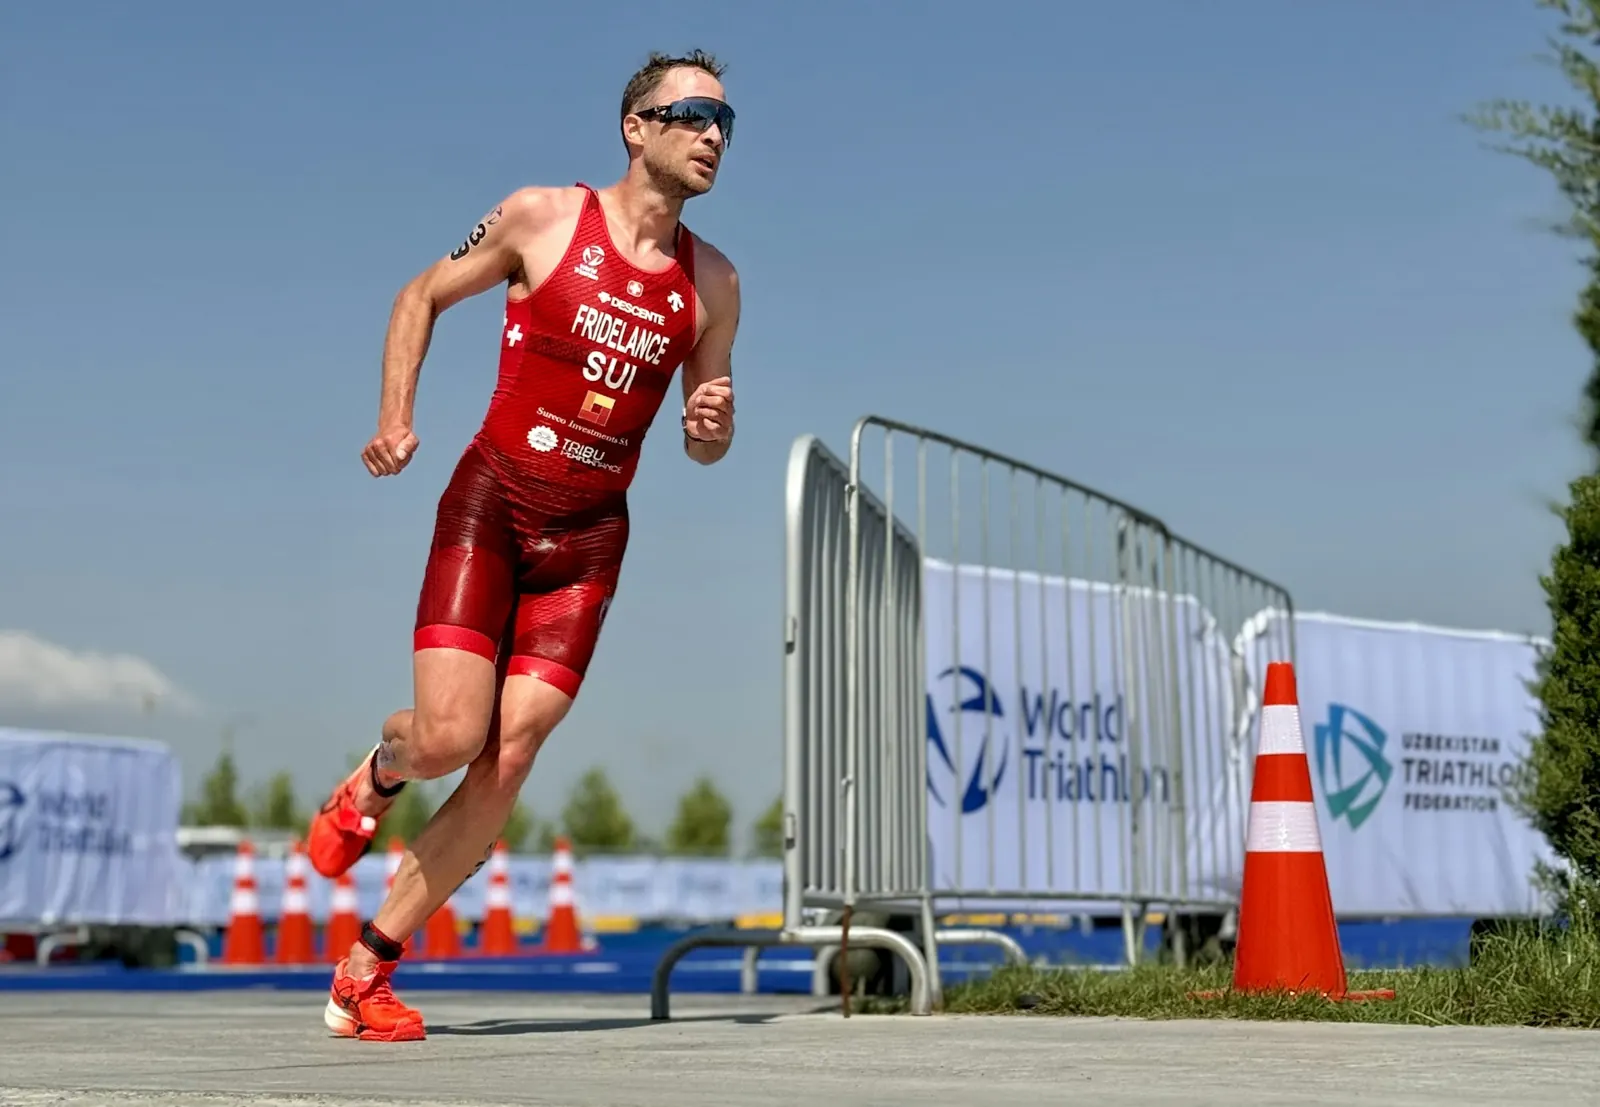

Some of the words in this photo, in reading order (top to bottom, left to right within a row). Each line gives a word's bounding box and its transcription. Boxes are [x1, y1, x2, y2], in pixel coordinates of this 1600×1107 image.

[610, 296, 666, 326] DESCENTE
[571, 304, 670, 366] FRIDELANCE
[582, 350, 638, 395] SUI
[536, 406, 567, 425] Sureco
[567, 420, 618, 445] Investments
[560, 438, 606, 461] TRIBU
[1021, 687, 1123, 742] World
[1401, 732, 1500, 754] UZBEKISTAN
[1404, 793, 1499, 813] FEDERATION
